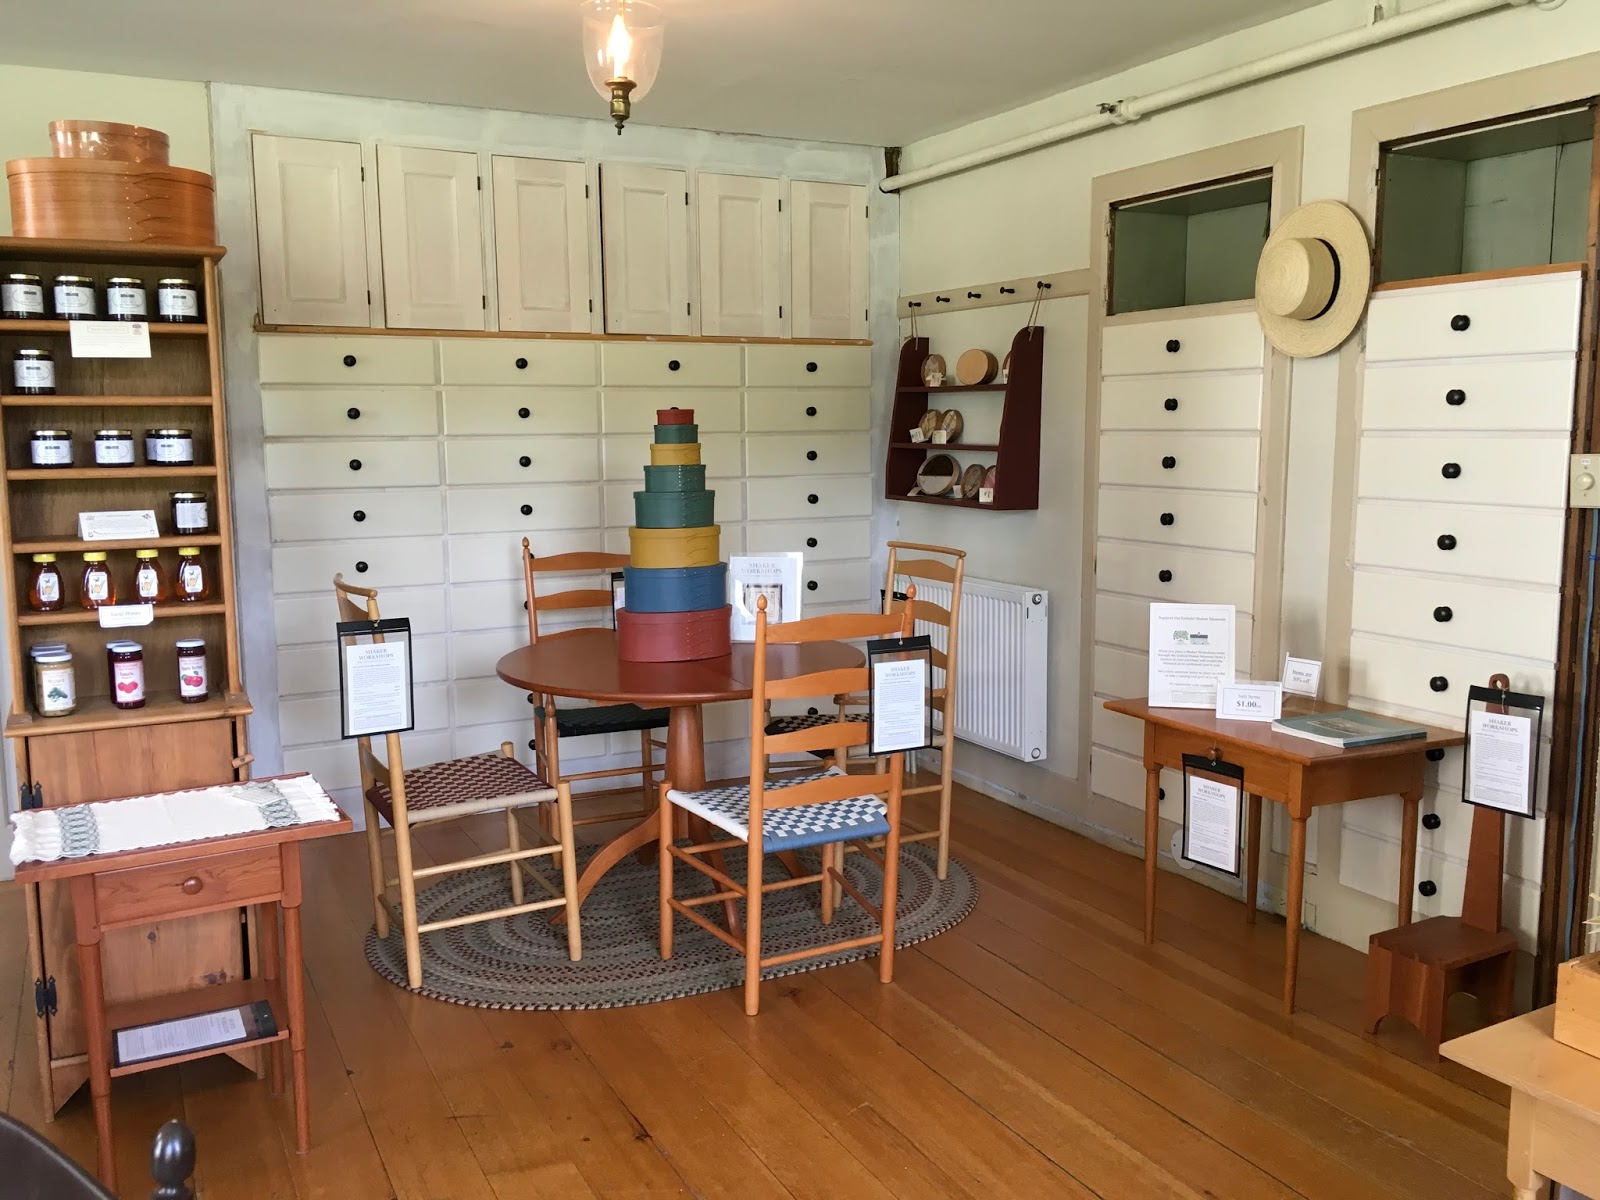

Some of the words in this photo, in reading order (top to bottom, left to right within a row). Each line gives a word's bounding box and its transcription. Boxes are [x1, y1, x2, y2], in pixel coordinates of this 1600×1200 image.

[1236, 700, 1256, 708] $1.00
[1489, 718, 1511, 726] SHAKER
[1482, 723, 1518, 732] WORKSHOPS
